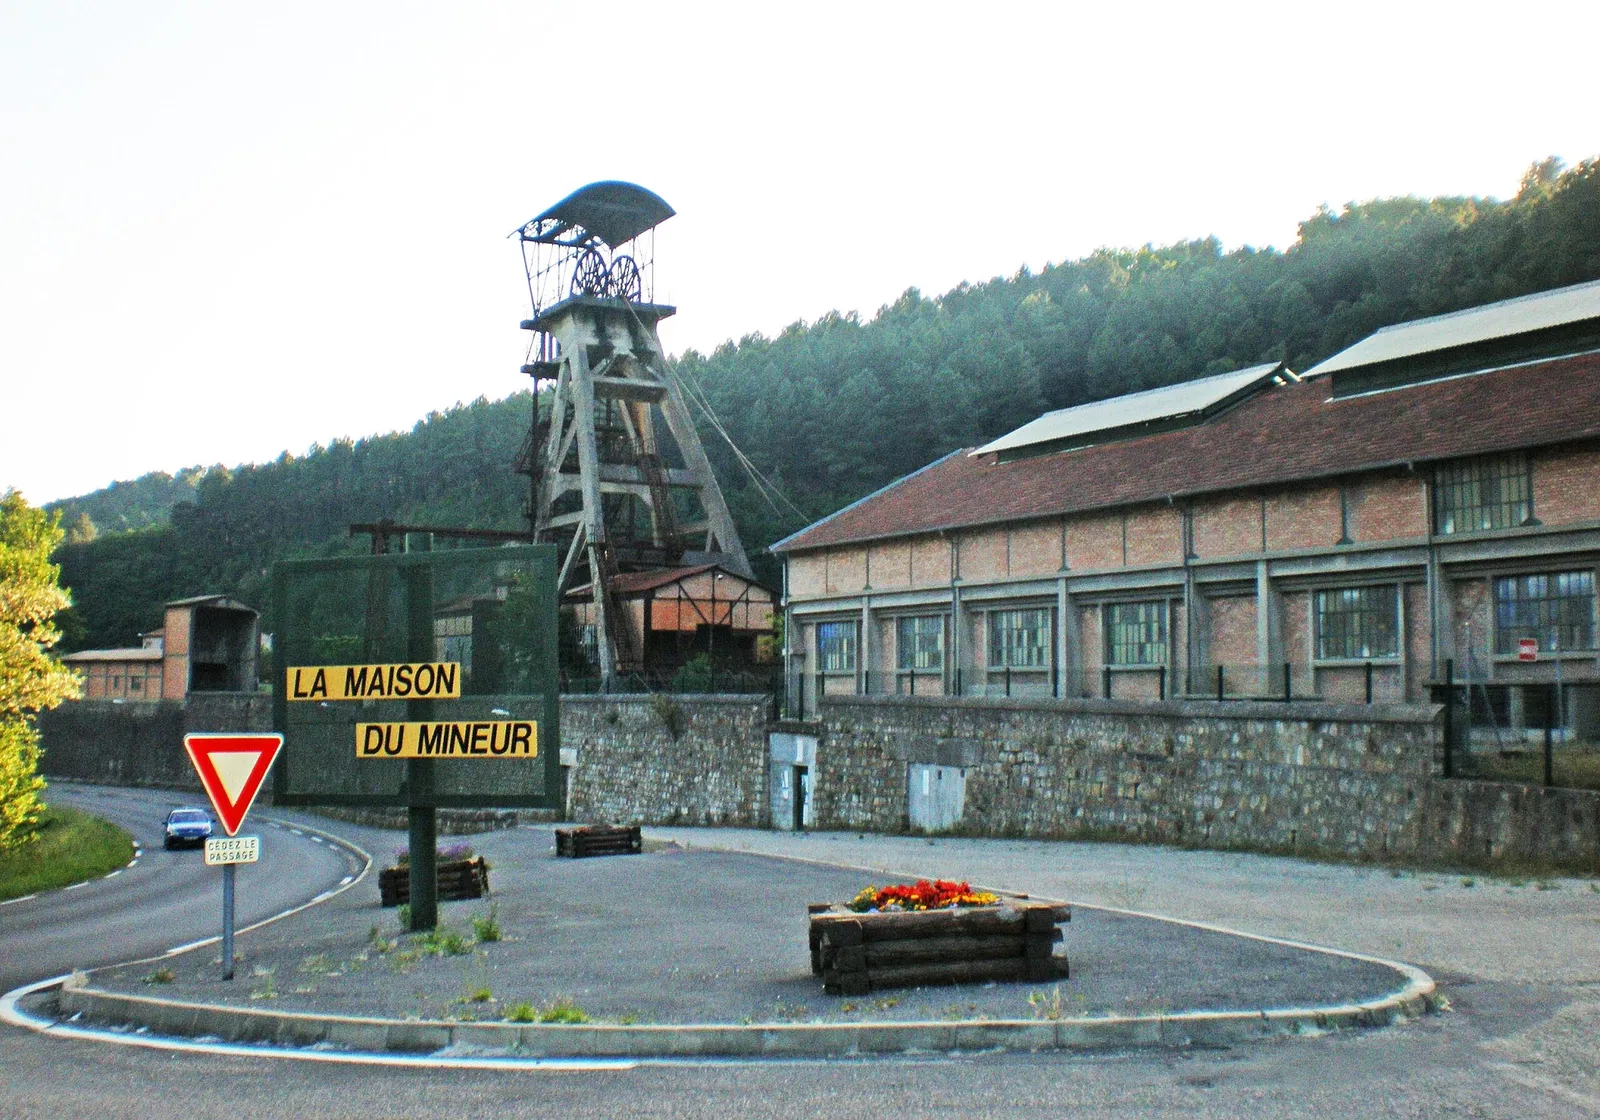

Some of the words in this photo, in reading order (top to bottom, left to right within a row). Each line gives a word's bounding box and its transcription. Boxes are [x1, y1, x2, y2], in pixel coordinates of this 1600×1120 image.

[293, 668, 328, 698] LA
[344, 664, 456, 697] MAISON
[363, 724, 405, 755] DU
[417, 723, 532, 755] MINEUR
[244, 839, 256, 849] LE
[209, 850, 254, 861] PASSAGE
